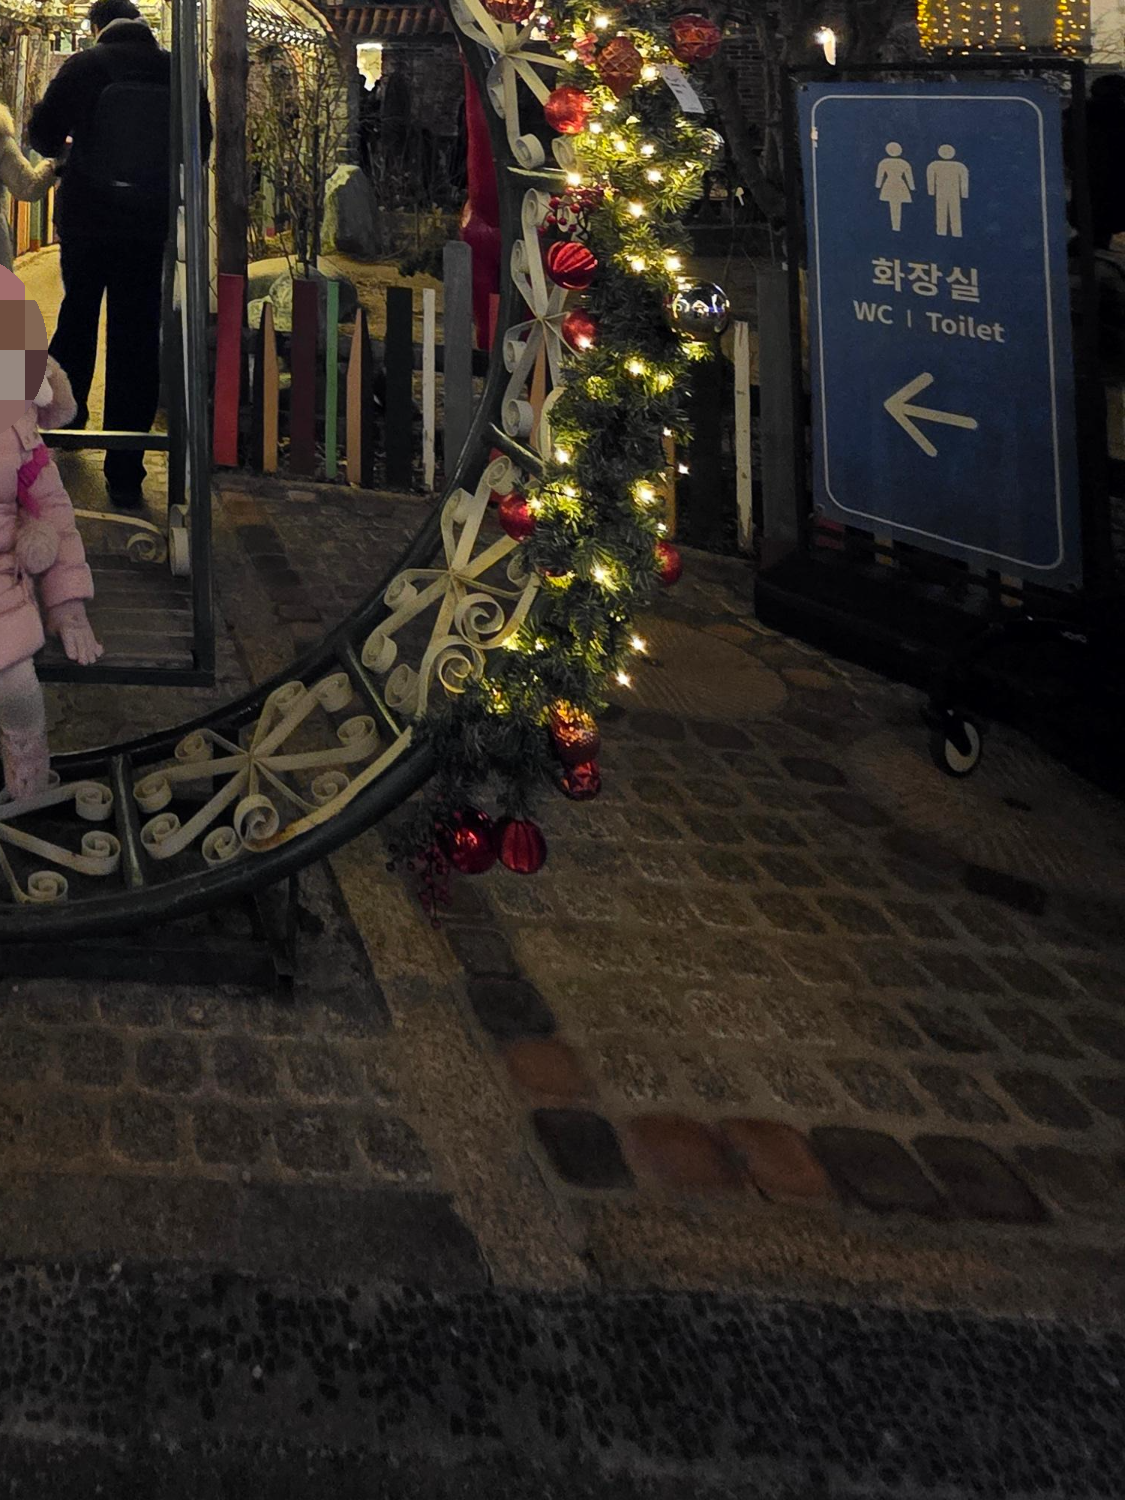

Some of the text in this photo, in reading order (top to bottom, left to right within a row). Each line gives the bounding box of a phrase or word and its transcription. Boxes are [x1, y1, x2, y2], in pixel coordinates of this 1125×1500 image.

[871, 257, 981, 303] 화장실
[853, 300, 1006, 344] WC Toilet
